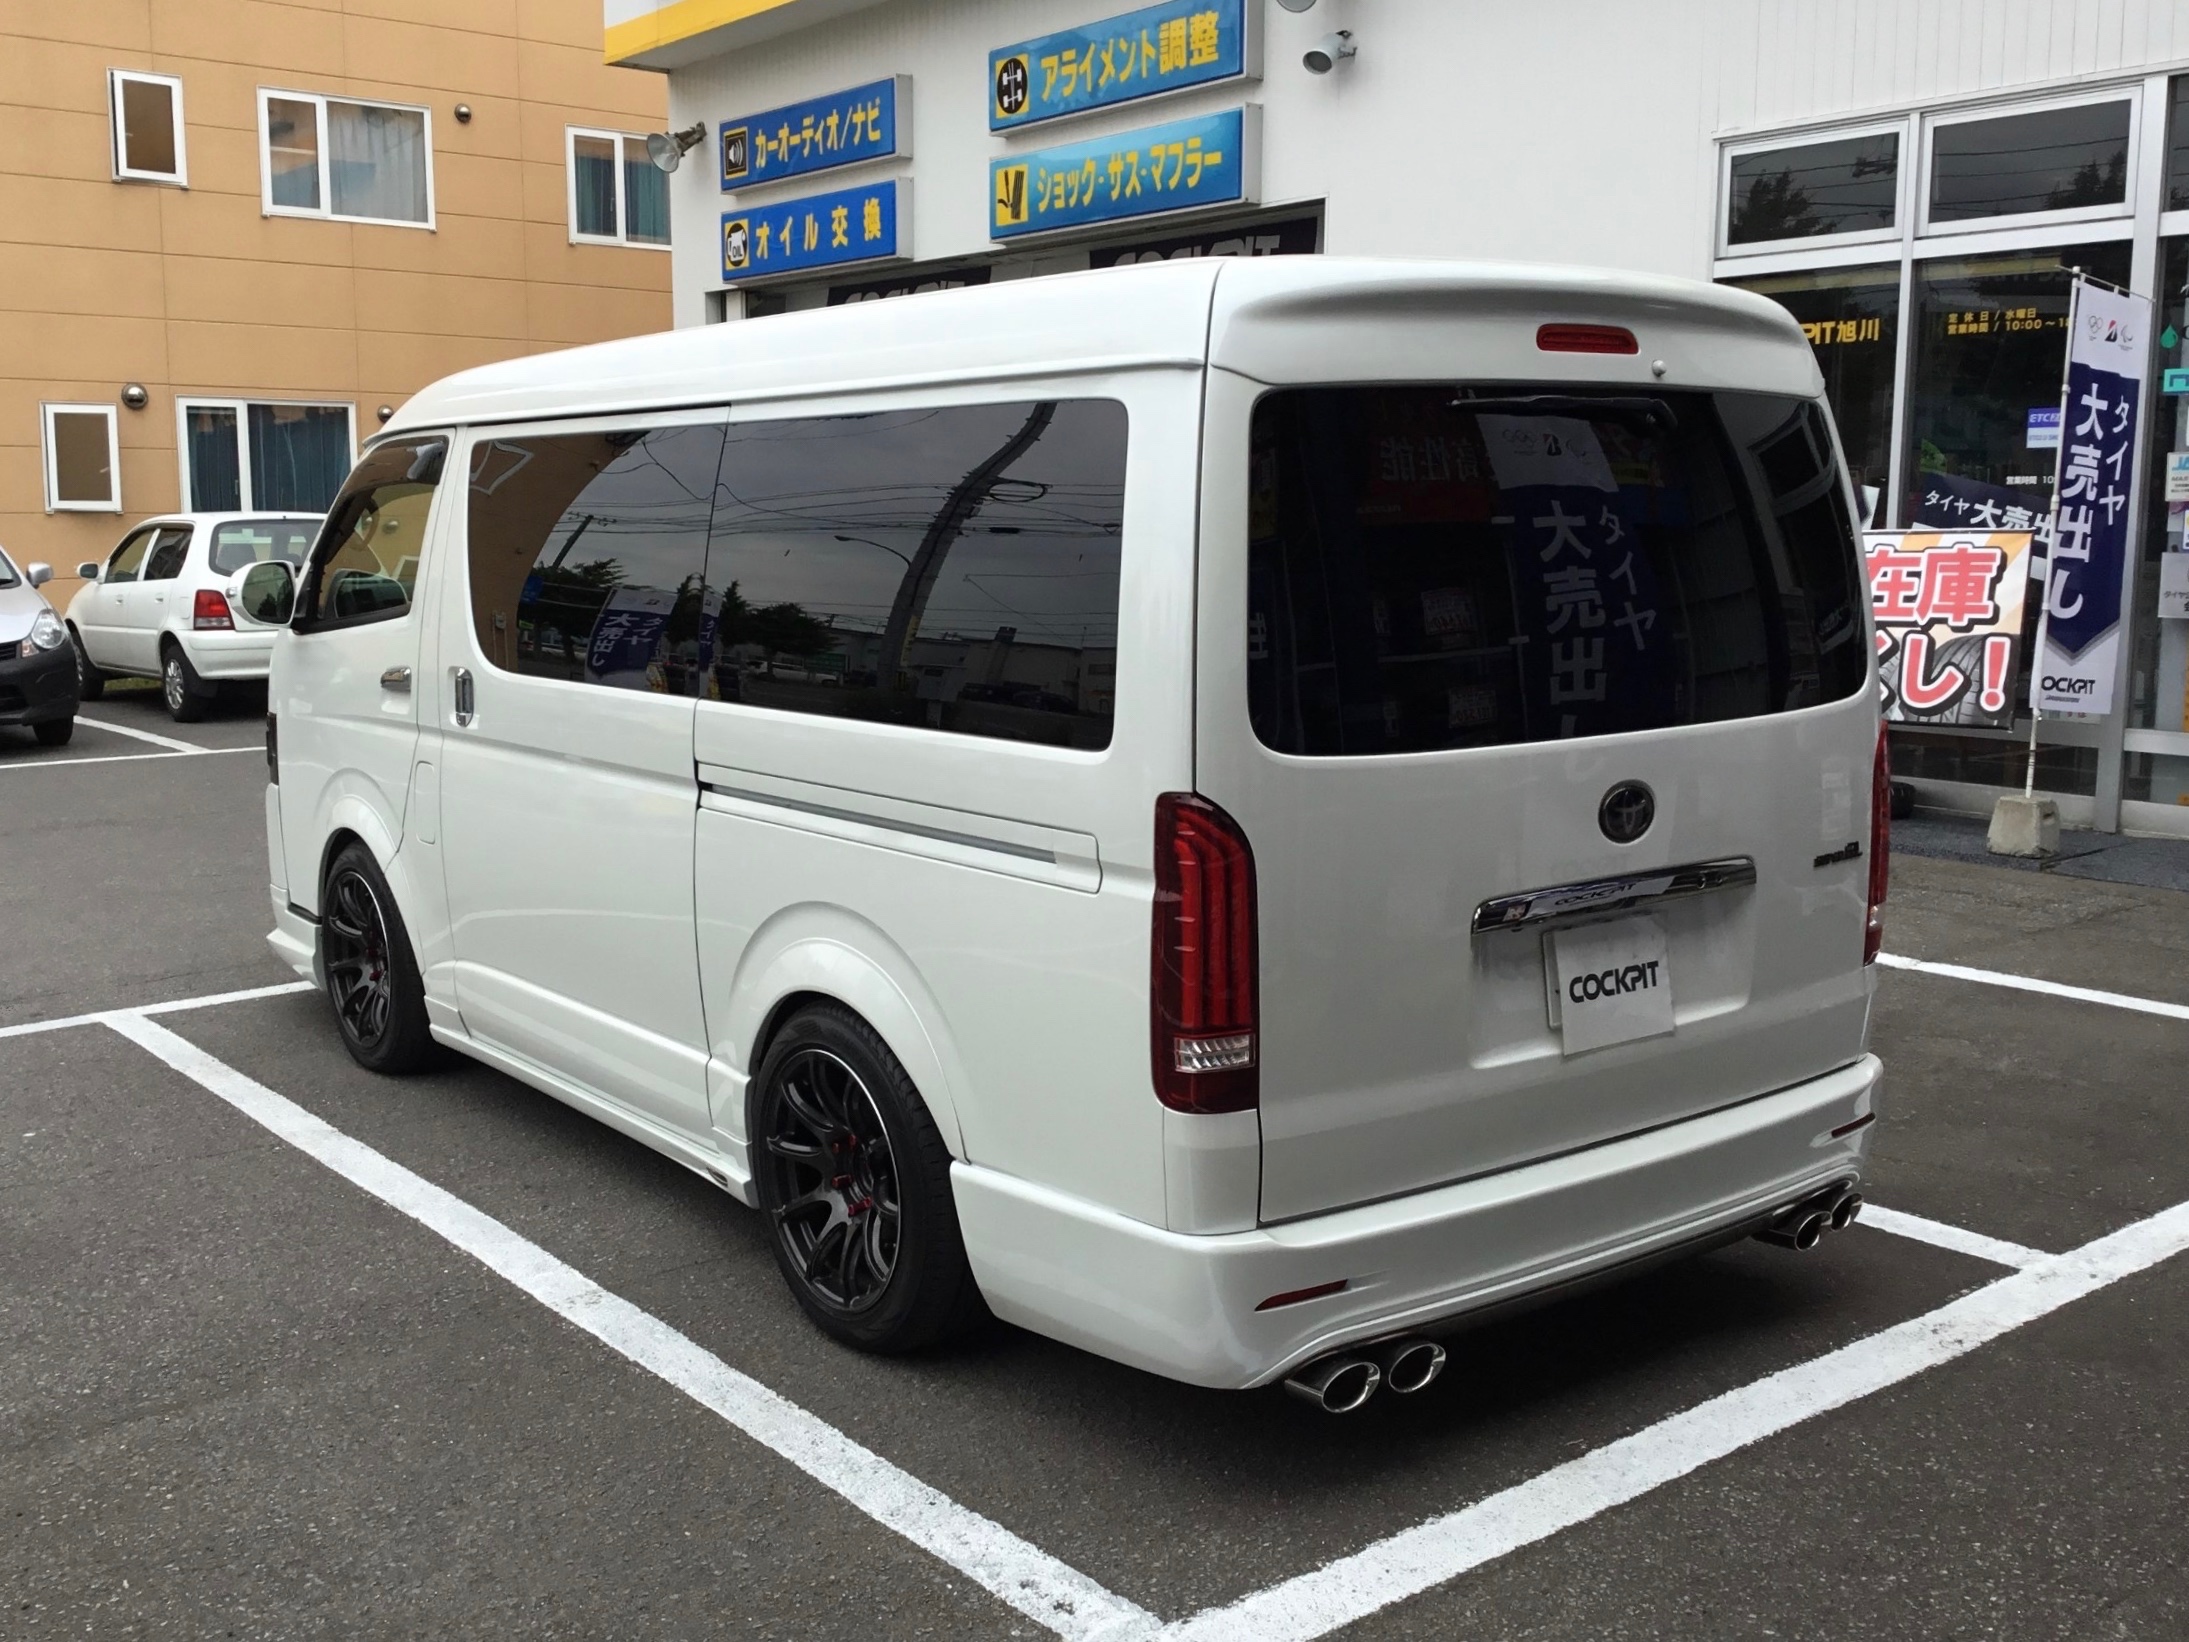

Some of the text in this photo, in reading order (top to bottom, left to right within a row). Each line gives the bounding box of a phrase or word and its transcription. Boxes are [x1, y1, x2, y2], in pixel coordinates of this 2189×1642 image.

[1041, 11, 1219, 101] アライメント調整
[755, 97, 881, 169] カーオーディオ/ナビ
[2099, 395, 2130, 526] タイヤ
[2049, 383, 2109, 620] 大売出し
[591, 613, 640, 667] 大売出し
[1569, 960, 1659, 1003] COCKPIT
